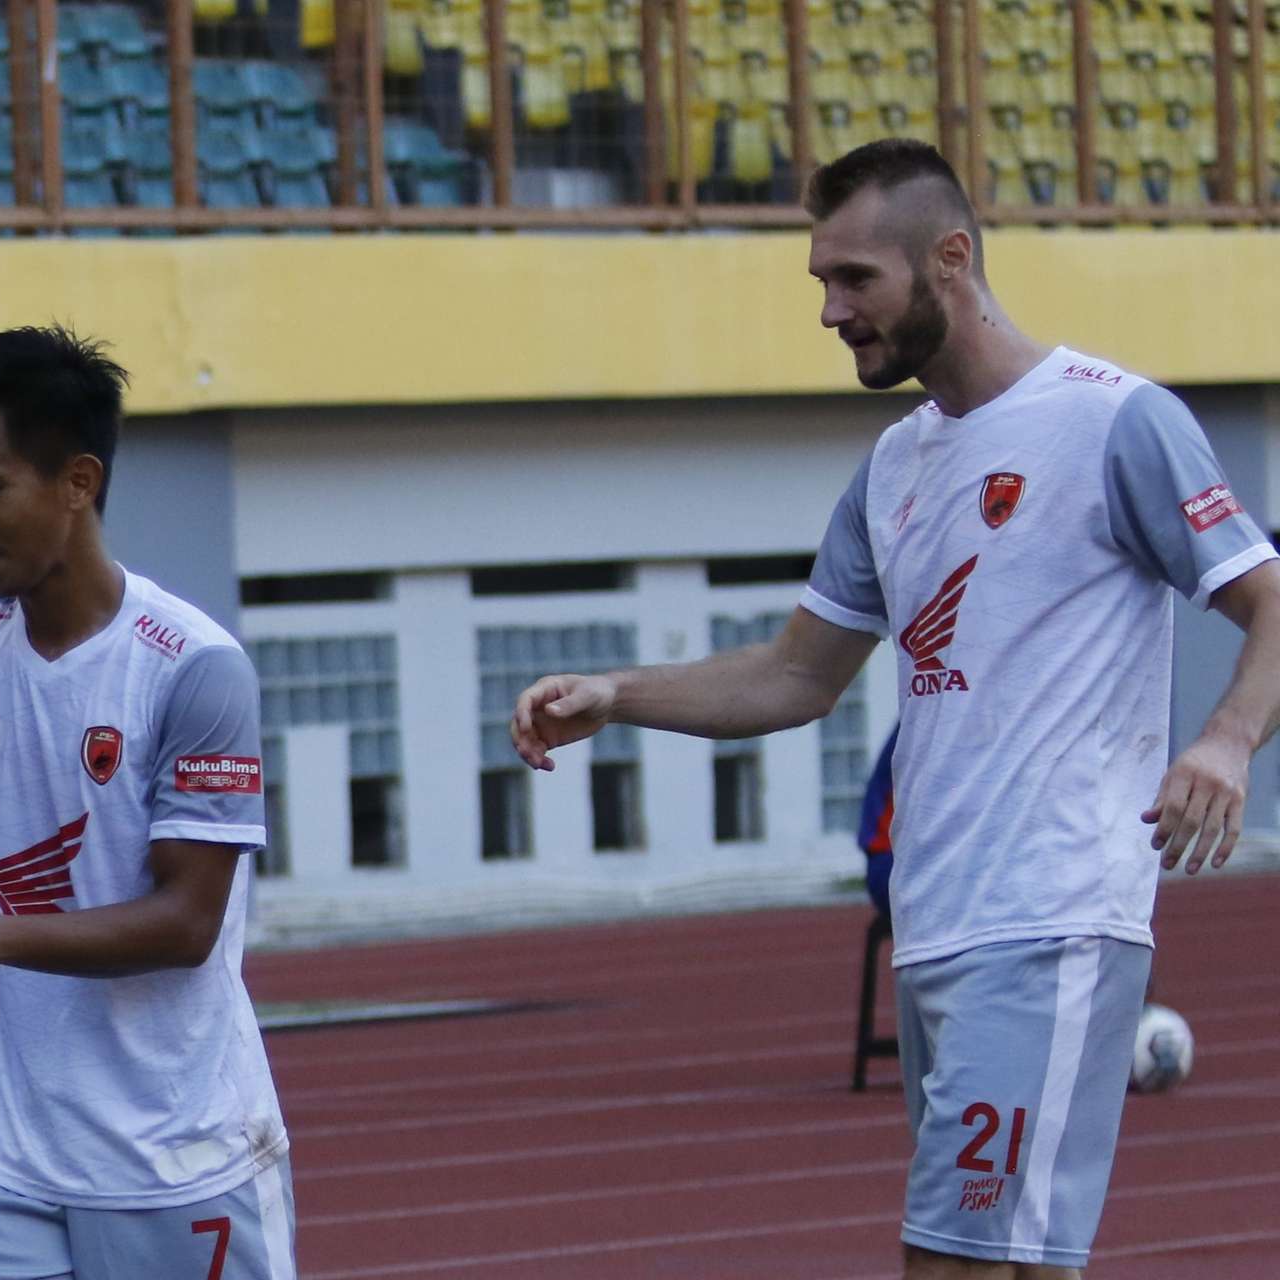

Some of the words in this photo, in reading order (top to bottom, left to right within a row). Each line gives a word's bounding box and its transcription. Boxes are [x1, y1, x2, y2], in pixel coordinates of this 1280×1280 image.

[1063, 364, 1123, 385] KALLA
[135, 613, 187, 654] KALLA
[178, 759, 259, 774] KukuBima
[956, 1102, 1026, 1175] 21
